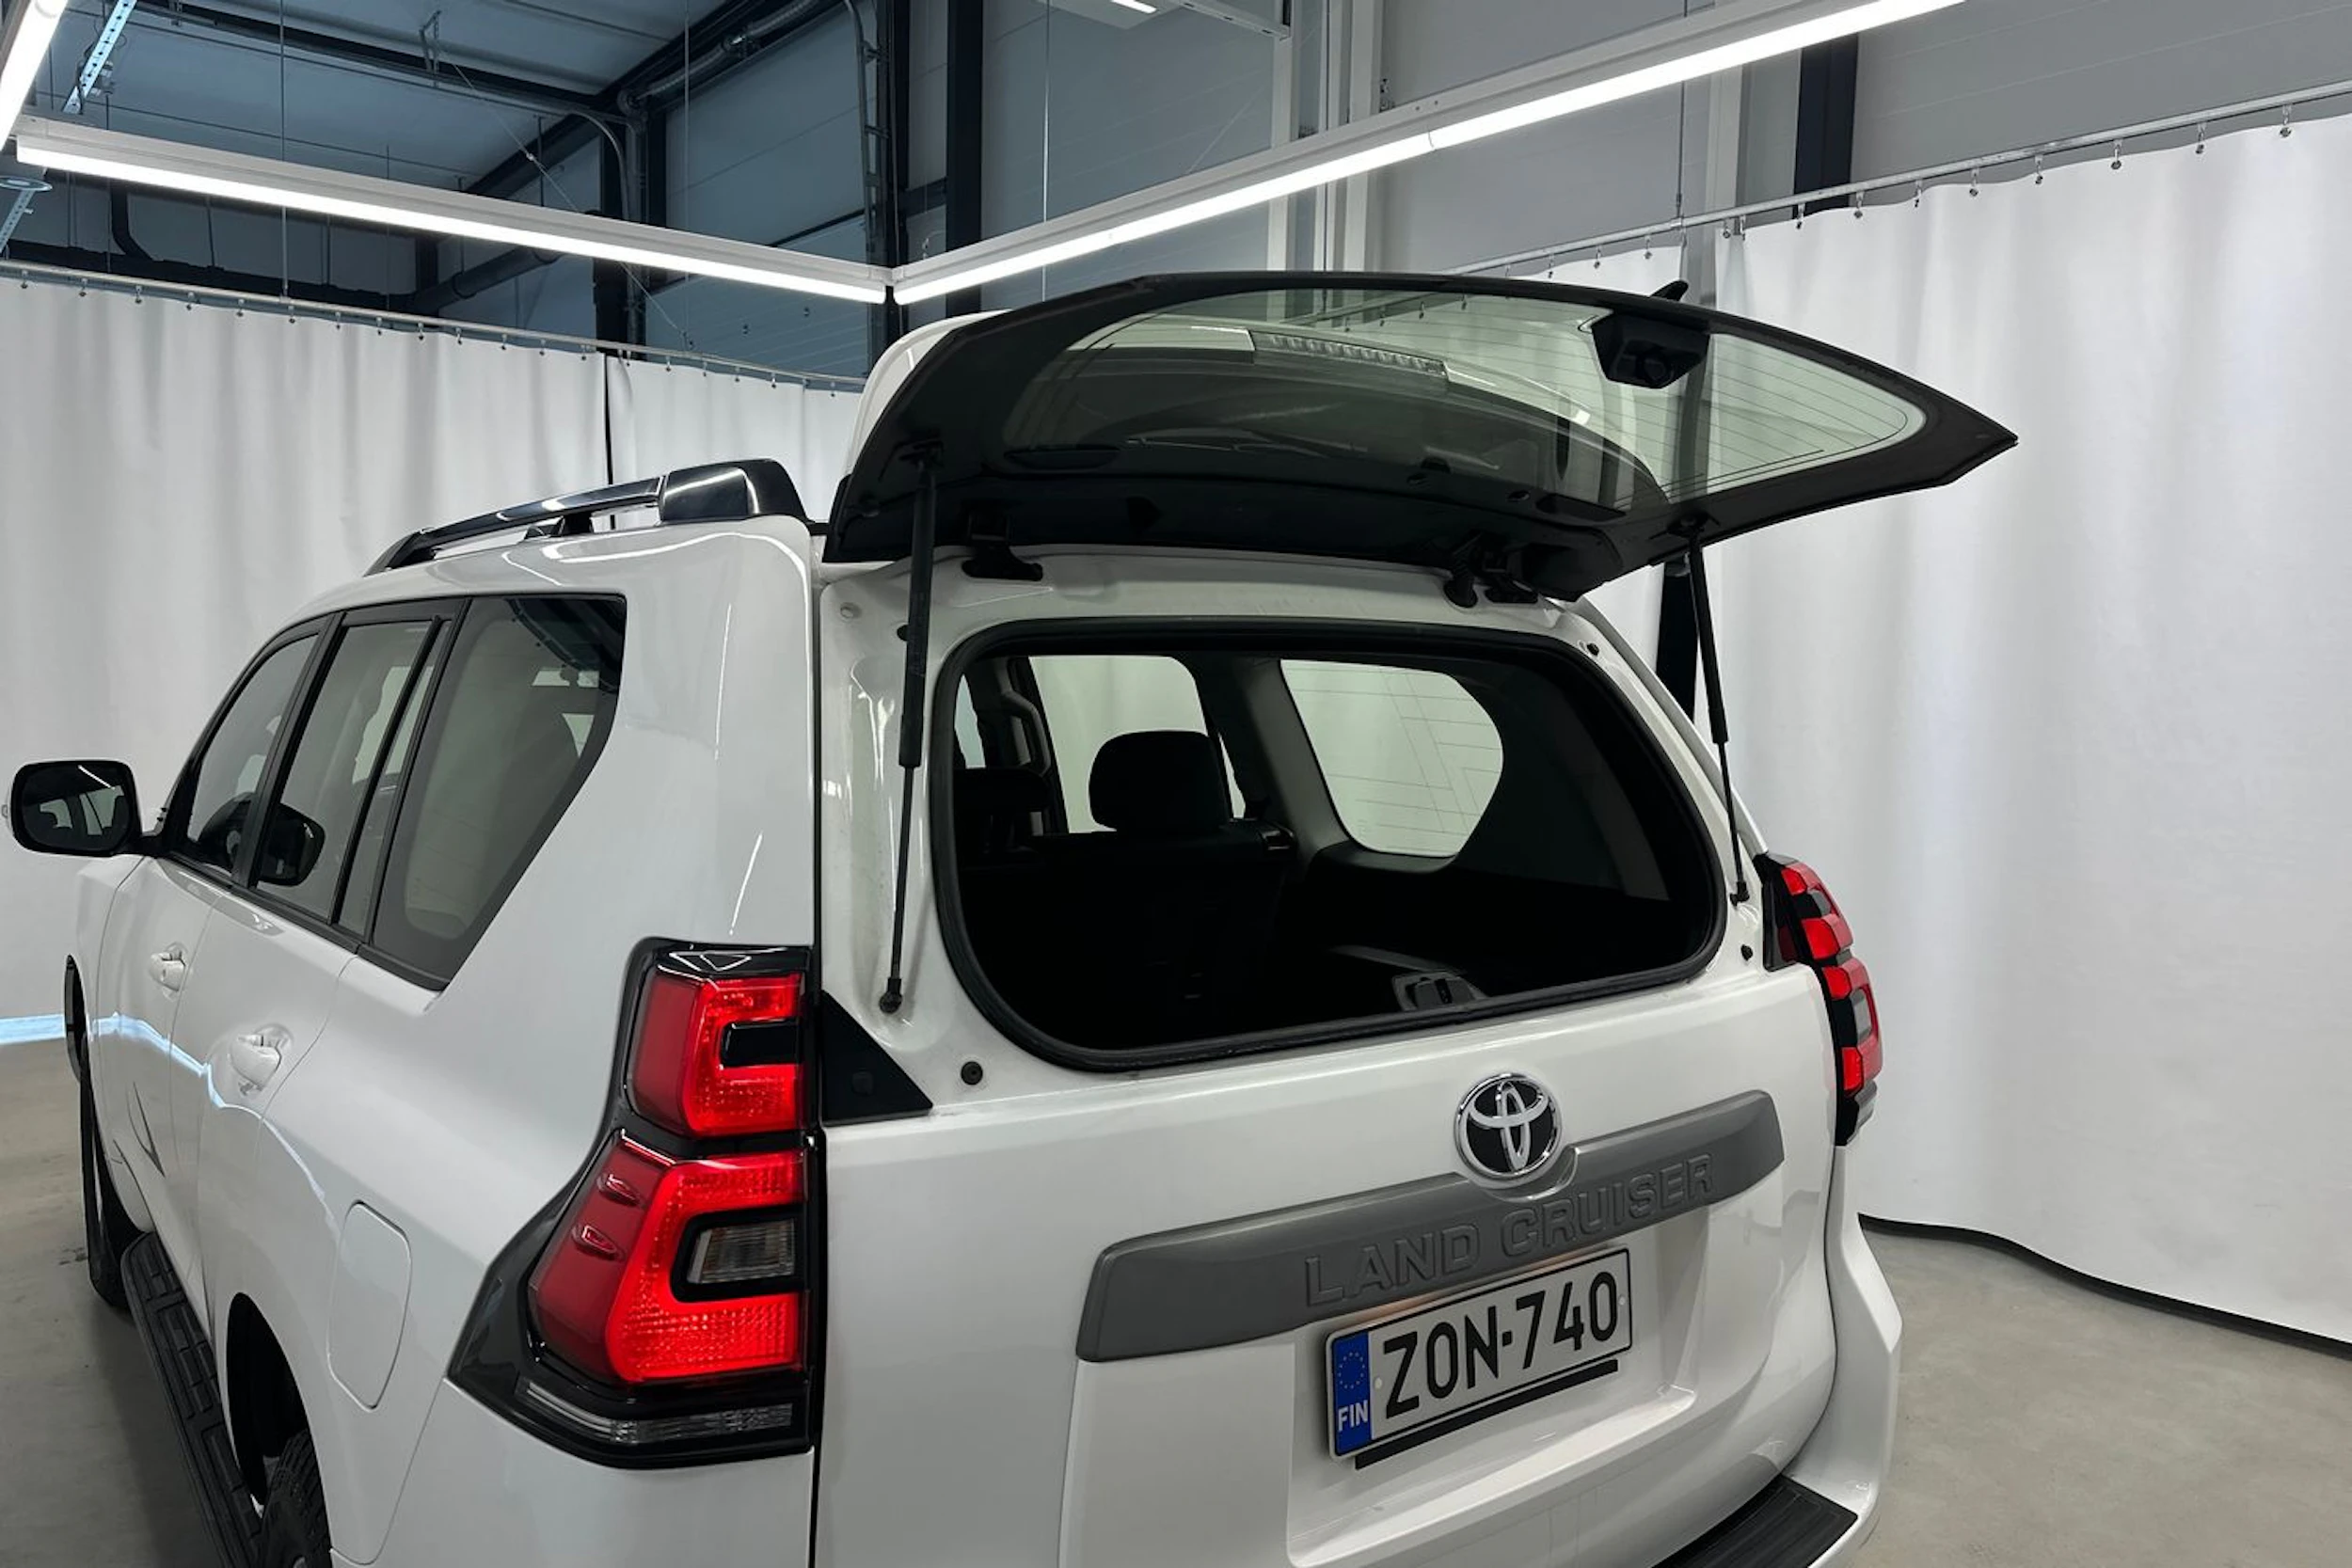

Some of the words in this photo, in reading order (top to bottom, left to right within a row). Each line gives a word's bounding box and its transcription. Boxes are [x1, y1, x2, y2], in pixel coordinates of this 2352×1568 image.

[1305, 1224, 1482, 1307] LAND
[1502, 1153, 1713, 1257] CRUISER
[1337, 1400, 1369, 1432] FIN
[1383, 1271, 1618, 1419] ZON-740
